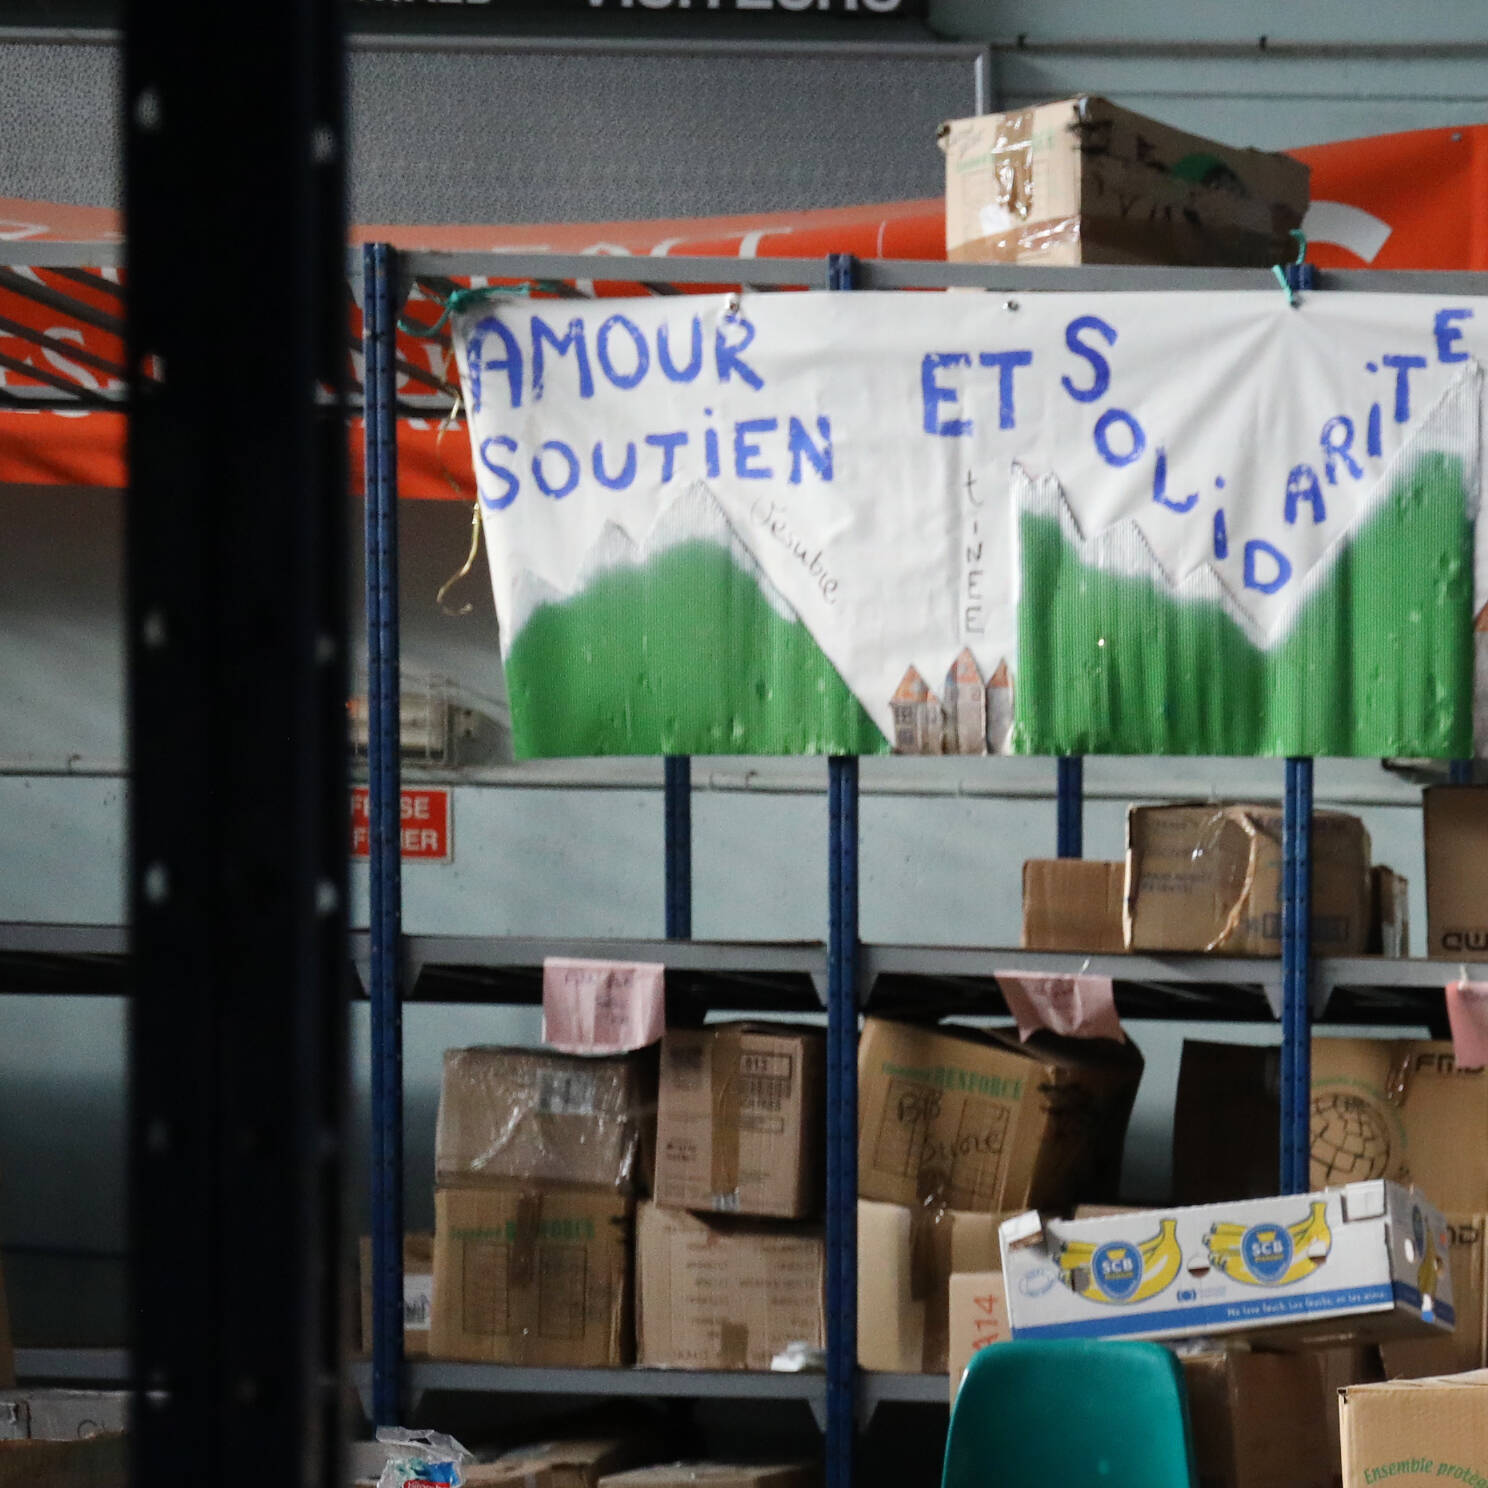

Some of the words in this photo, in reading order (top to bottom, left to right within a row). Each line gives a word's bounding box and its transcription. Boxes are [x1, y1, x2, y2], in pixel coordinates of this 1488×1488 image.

[466, 314, 764, 413] AMOUR
[922, 350, 1033, 437] ET
[1252, 1241, 1283, 1257] SCB
[1102, 1257, 1133, 1275] SCB
[1363, 1458, 1434, 1487] Ensemble
